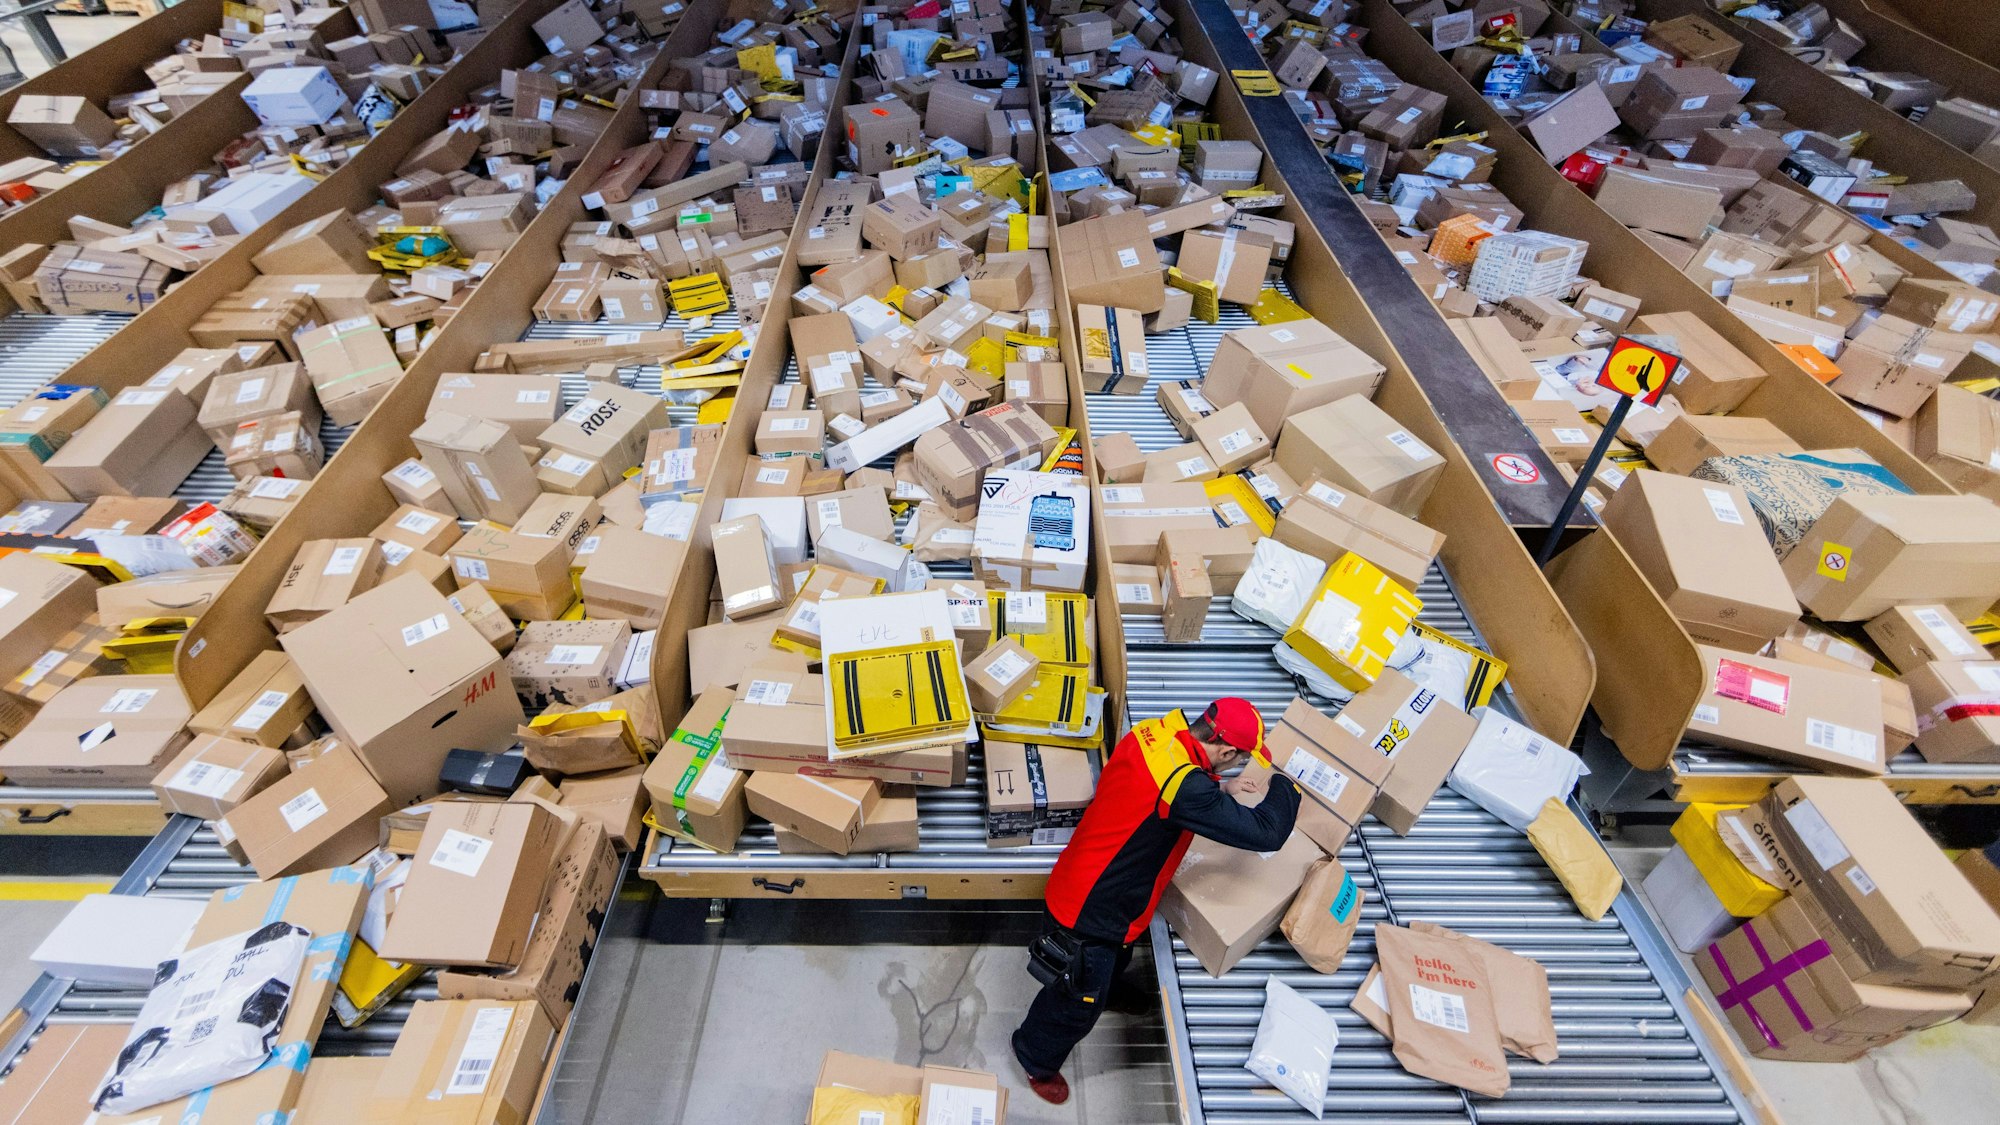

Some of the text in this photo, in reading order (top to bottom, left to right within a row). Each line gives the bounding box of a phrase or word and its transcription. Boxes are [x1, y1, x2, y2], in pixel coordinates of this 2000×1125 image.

[581, 399, 621, 436] ROSE
[547, 512, 569, 535] asos
[569, 519, 588, 546] asos
[283, 563, 304, 588] HSE
[464, 671, 495, 707] H&M
[1753, 822, 1802, 888] öffnen!
[1414, 955, 1455, 974] hello,
[1417, 968, 1476, 989] i'm here
